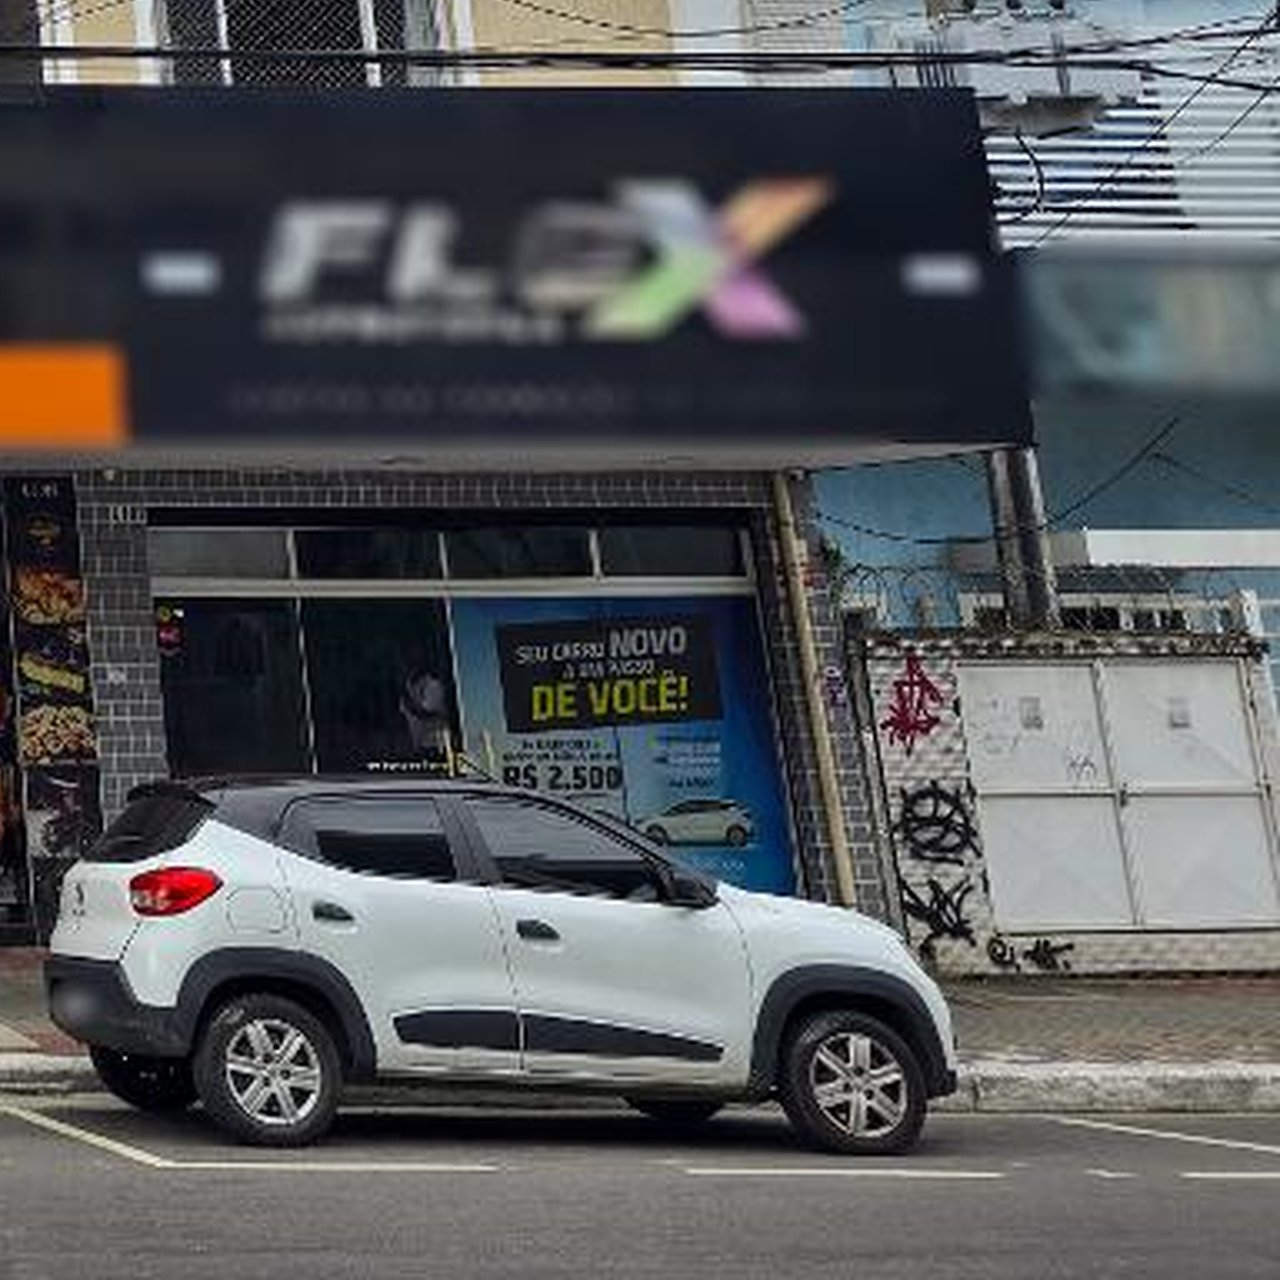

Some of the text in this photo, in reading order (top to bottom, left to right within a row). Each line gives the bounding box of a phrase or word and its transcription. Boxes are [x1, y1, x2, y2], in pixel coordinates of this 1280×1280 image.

[609, 625, 687, 658] NOVO
[532, 669, 689, 721] DE VOCÊ!
[503, 764, 623, 791] R$ 2.500
